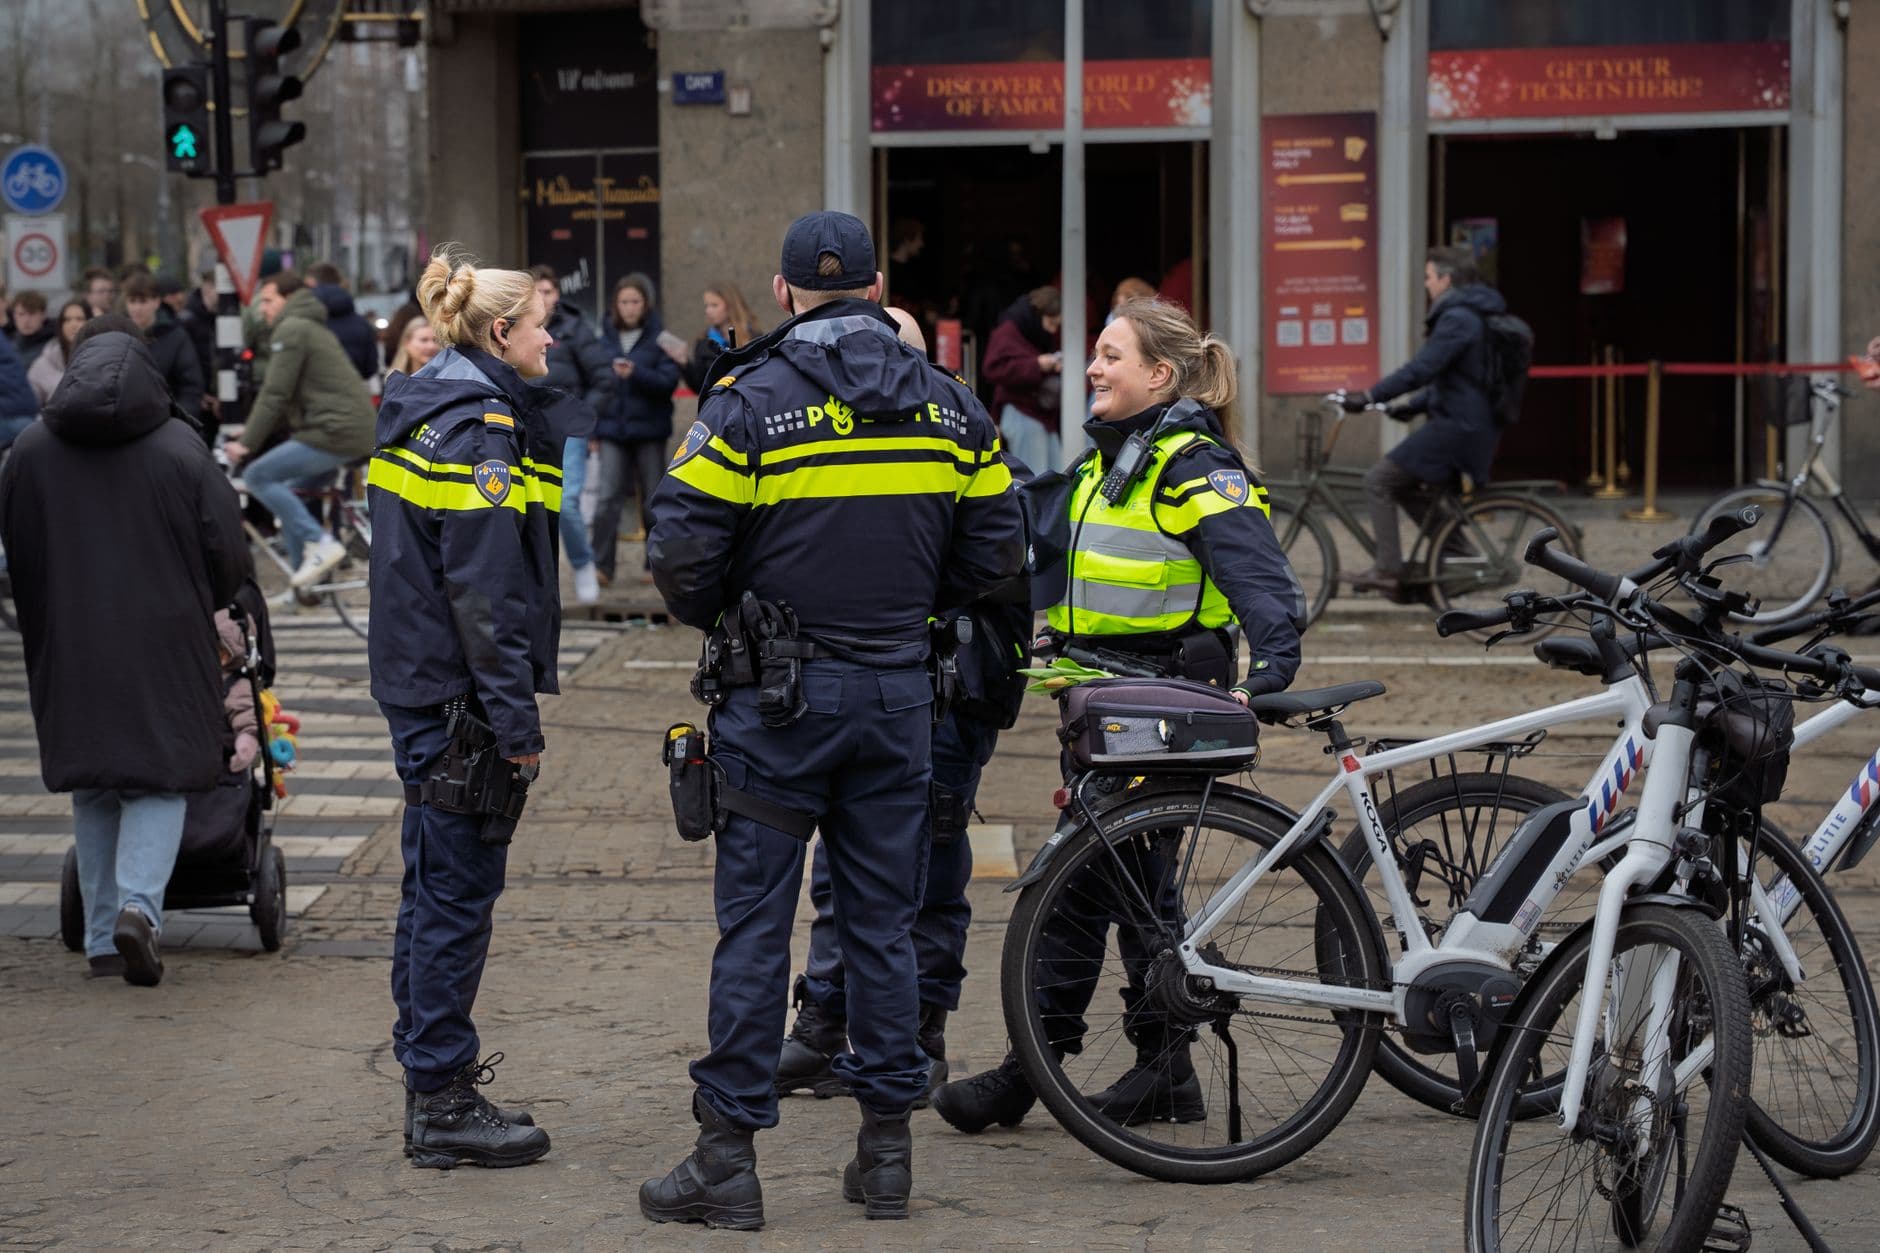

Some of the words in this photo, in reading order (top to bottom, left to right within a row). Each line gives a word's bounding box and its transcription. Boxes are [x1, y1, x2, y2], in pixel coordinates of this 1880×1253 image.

[1545, 59, 1600, 80] GET
[1601, 56, 1670, 77] YOUR
[926, 77, 1042, 97] DISCOVER
[1085, 75, 1155, 94] ORLD
[1517, 81, 1622, 101] TICKETS
[1626, 77, 1703, 97] HERE!
[946, 98, 977, 116] OF
[982, 96, 1062, 115] FAMOU
[478, 465, 507, 476] POLITIE
[1360, 792, 1387, 854] KOGA
[1811, 813, 1848, 867] OLITIE
[1553, 840, 1589, 891] POLITIE
